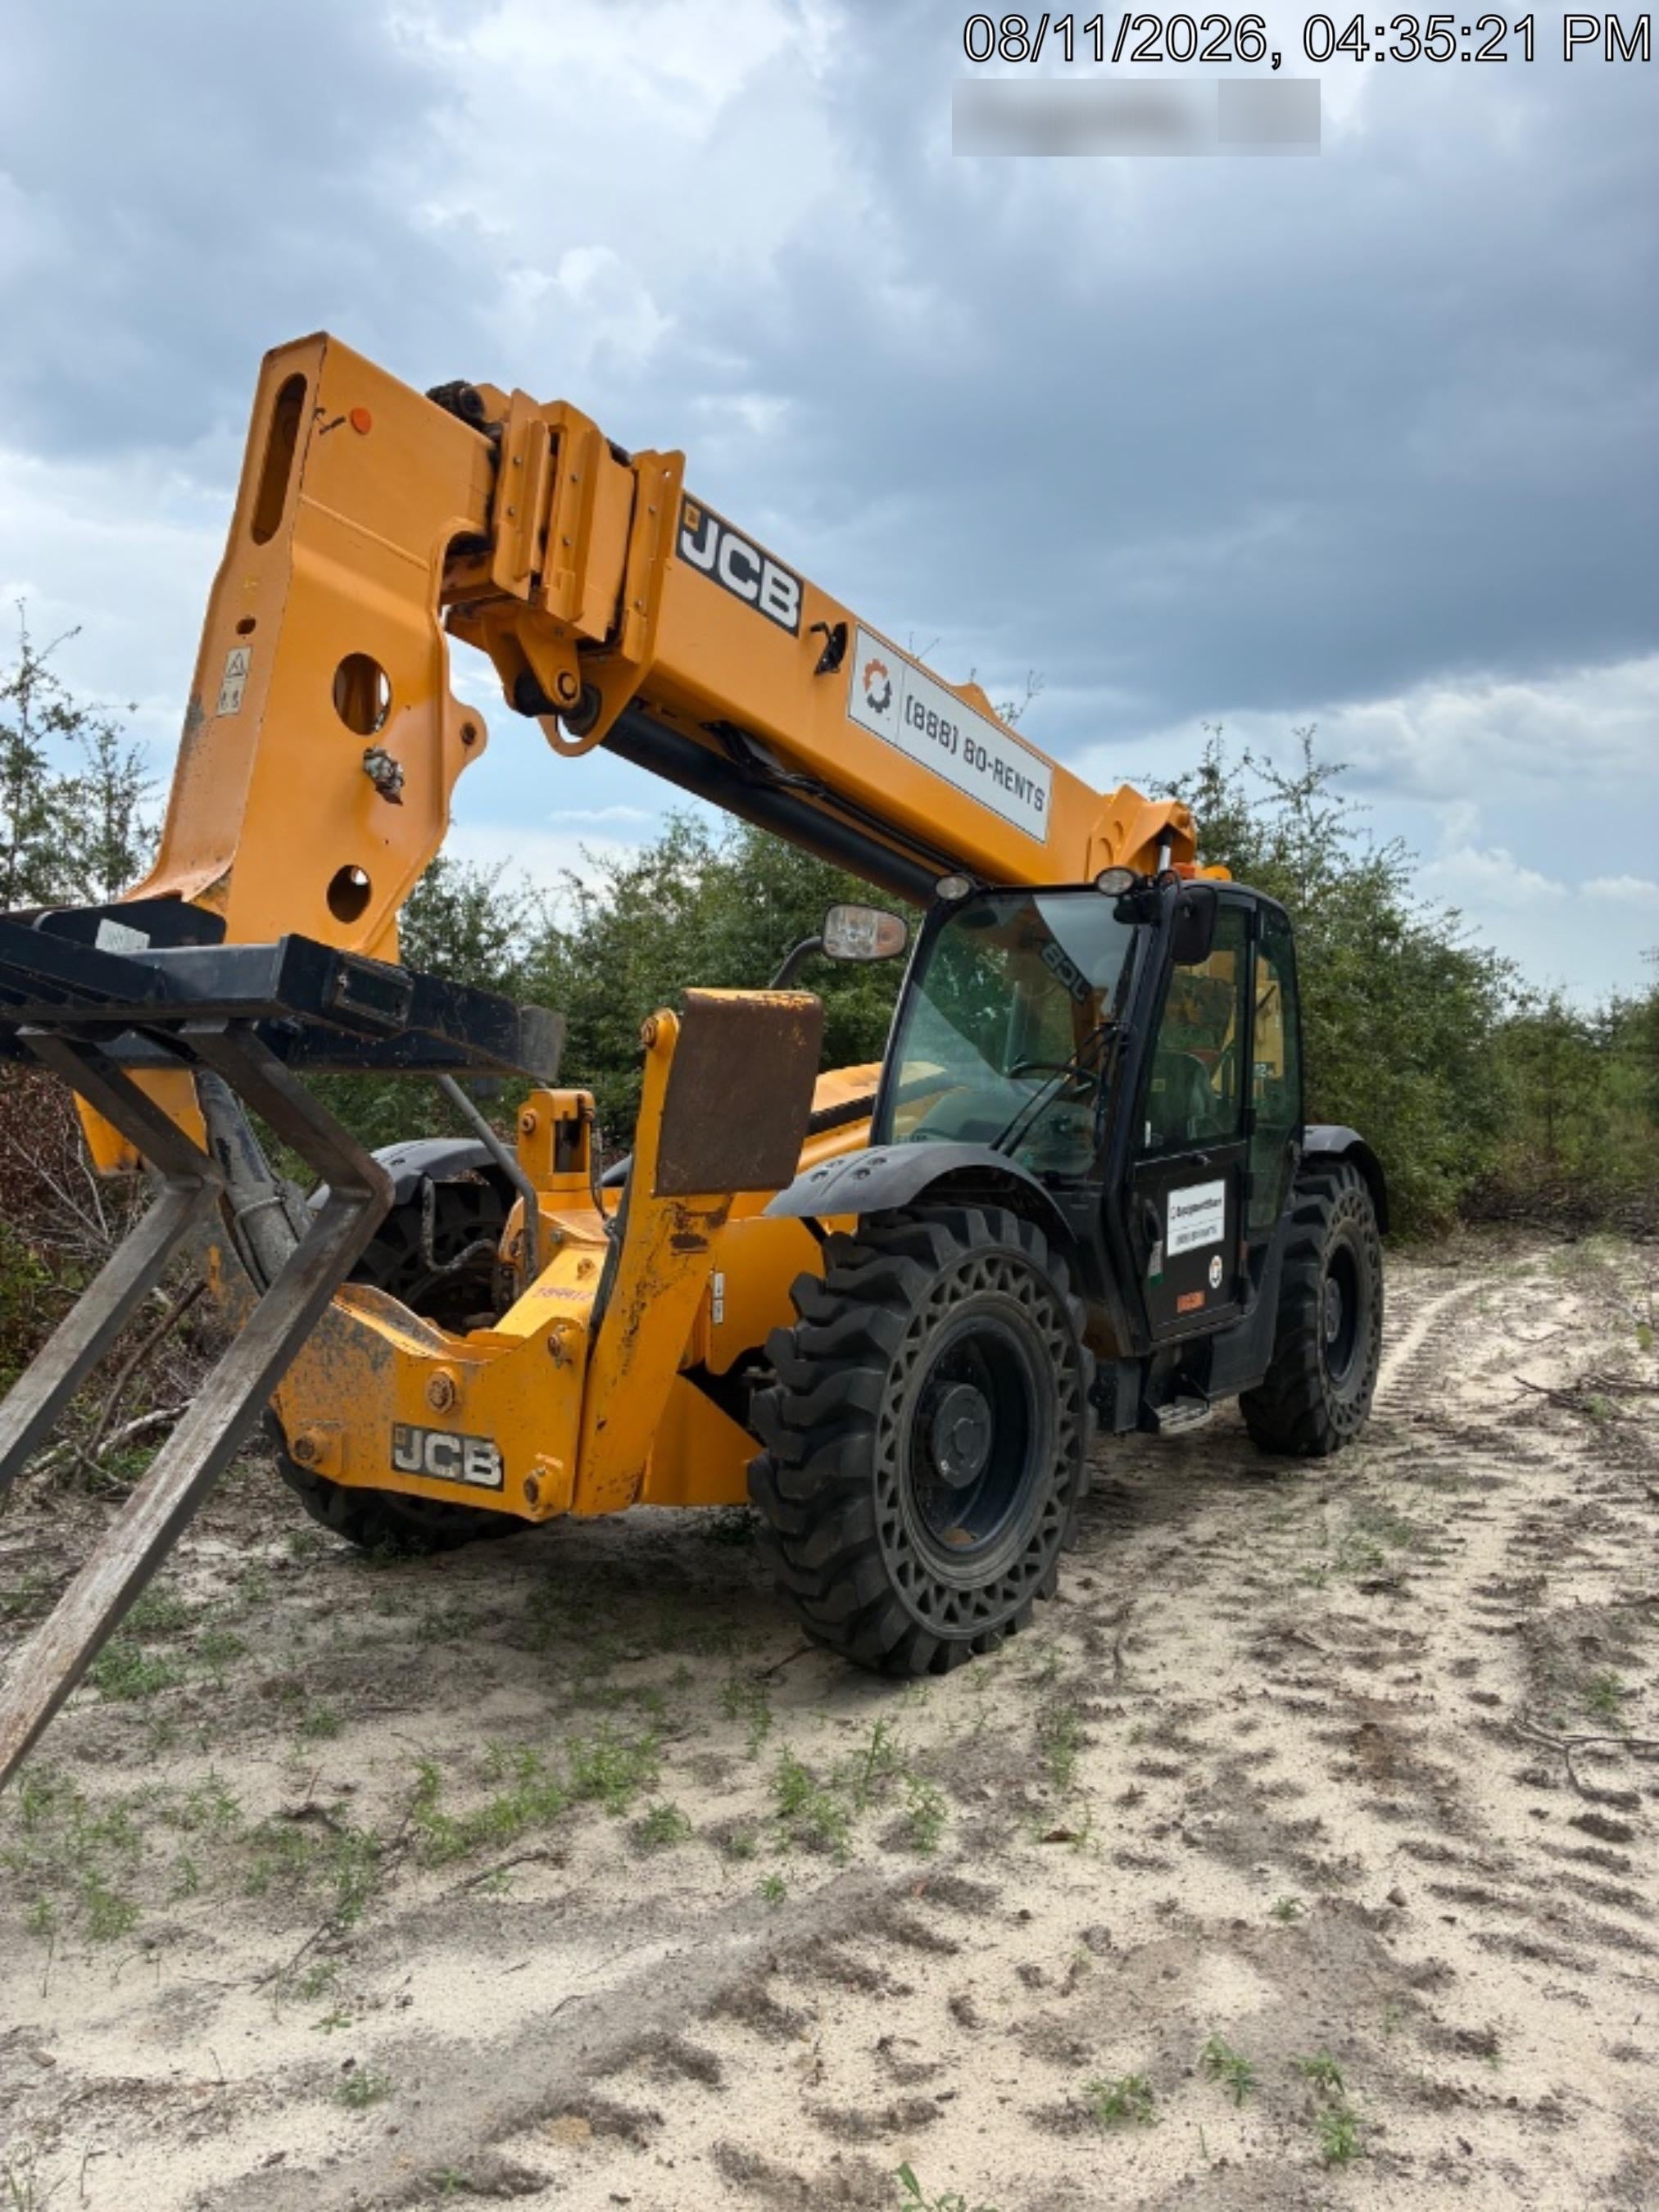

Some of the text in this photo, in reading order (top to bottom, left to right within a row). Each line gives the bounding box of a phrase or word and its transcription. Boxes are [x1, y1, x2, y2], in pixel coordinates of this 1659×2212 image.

[682, 519, 800, 628] JCB
[904, 694, 1045, 812] (888) 80-RENTS
[394, 1429, 502, 1486] JCB
